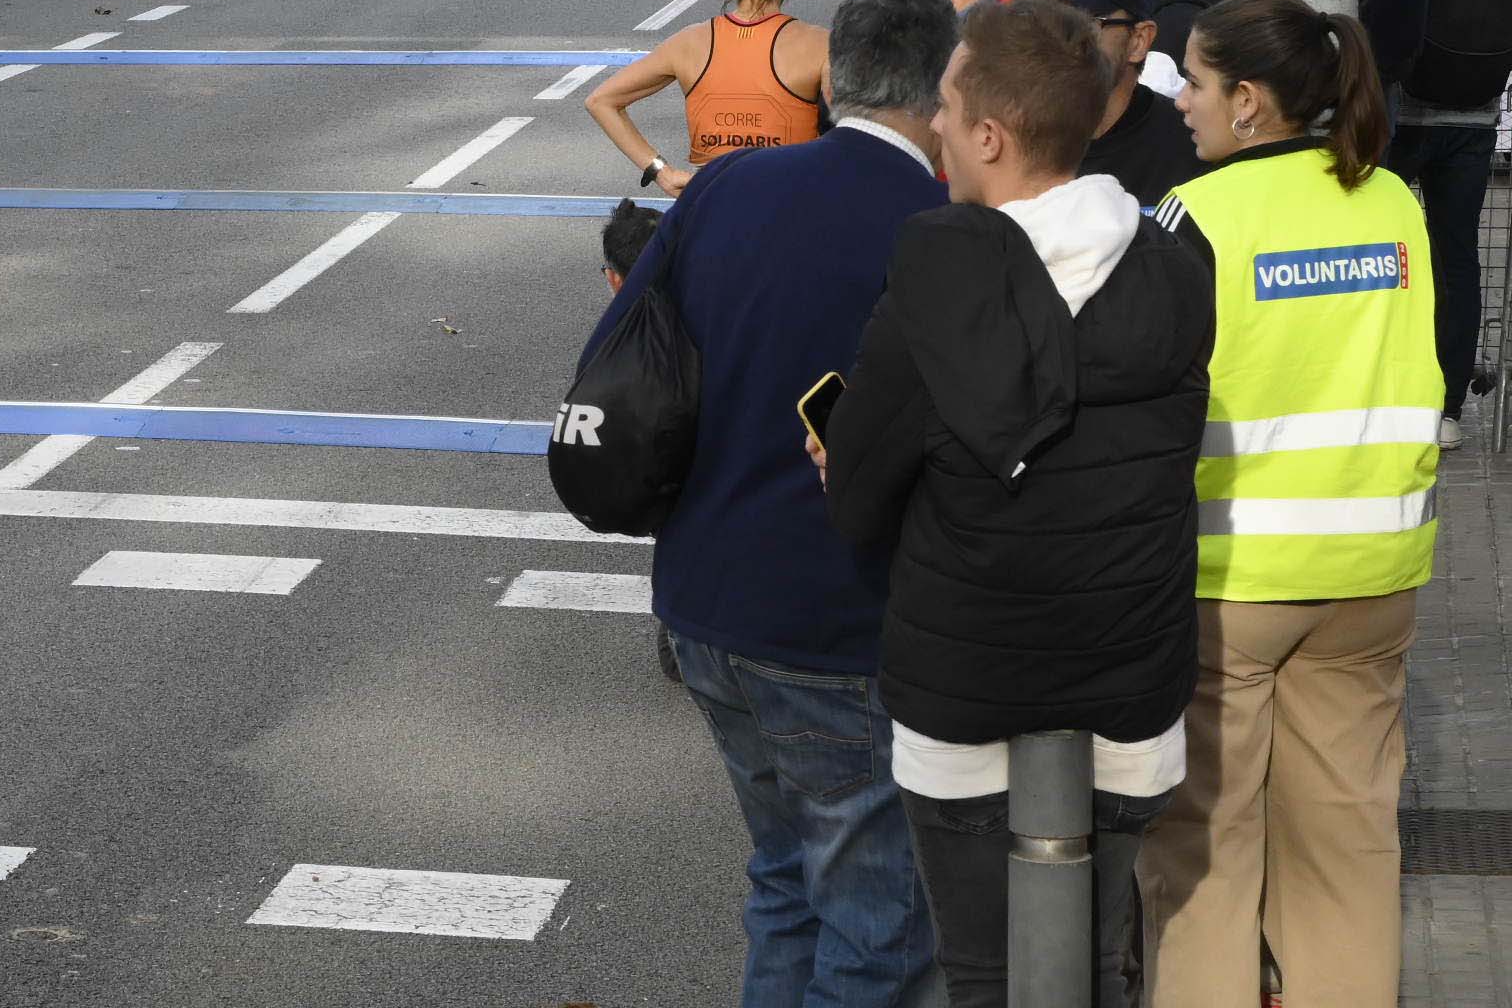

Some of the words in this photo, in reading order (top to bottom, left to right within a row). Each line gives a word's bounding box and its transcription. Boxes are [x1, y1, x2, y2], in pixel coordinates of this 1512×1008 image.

[714, 112, 763, 128] CORRE
[700, 133, 782, 149] SOLIDARIS
[1258, 255, 1397, 288] VOLUNTARIS
